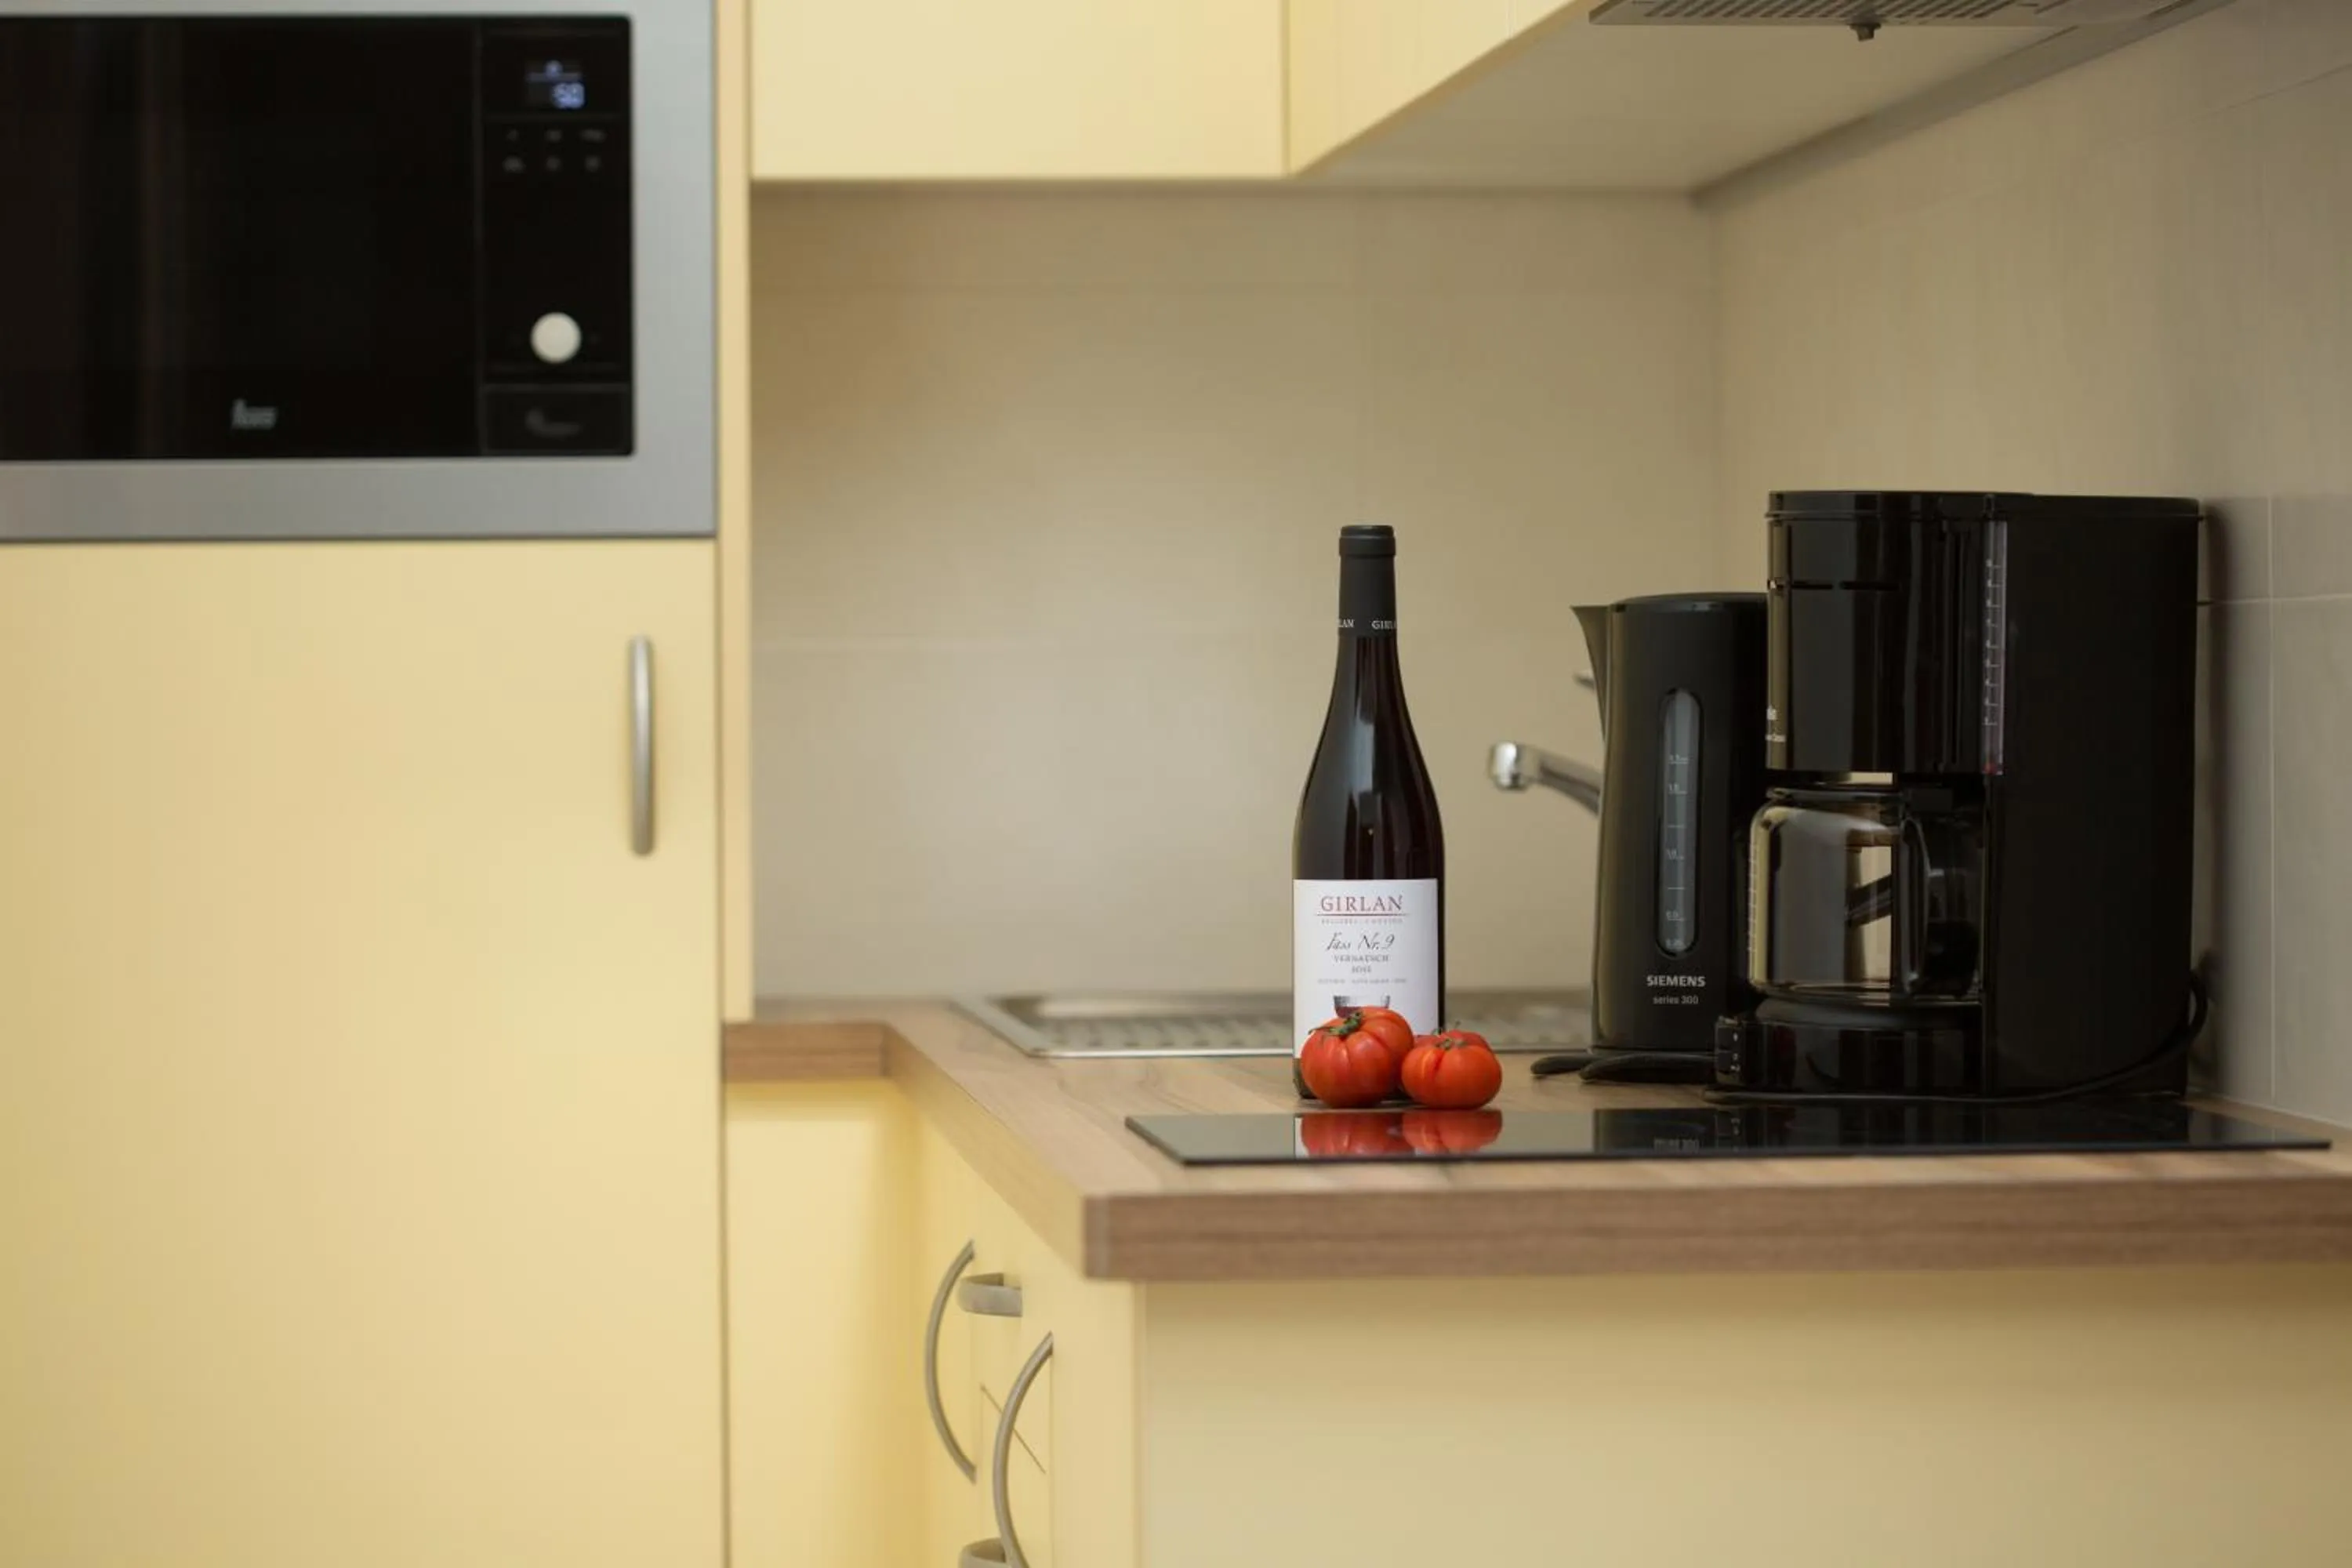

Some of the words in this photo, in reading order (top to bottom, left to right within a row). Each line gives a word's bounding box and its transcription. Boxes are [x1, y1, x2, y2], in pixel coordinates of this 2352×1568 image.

[1320, 895, 1403, 912] GIRLAN
[1646, 975, 1706, 987] SIEMENS
[1653, 996, 1679, 1004] series
[1680, 995, 1699, 1004] 300
